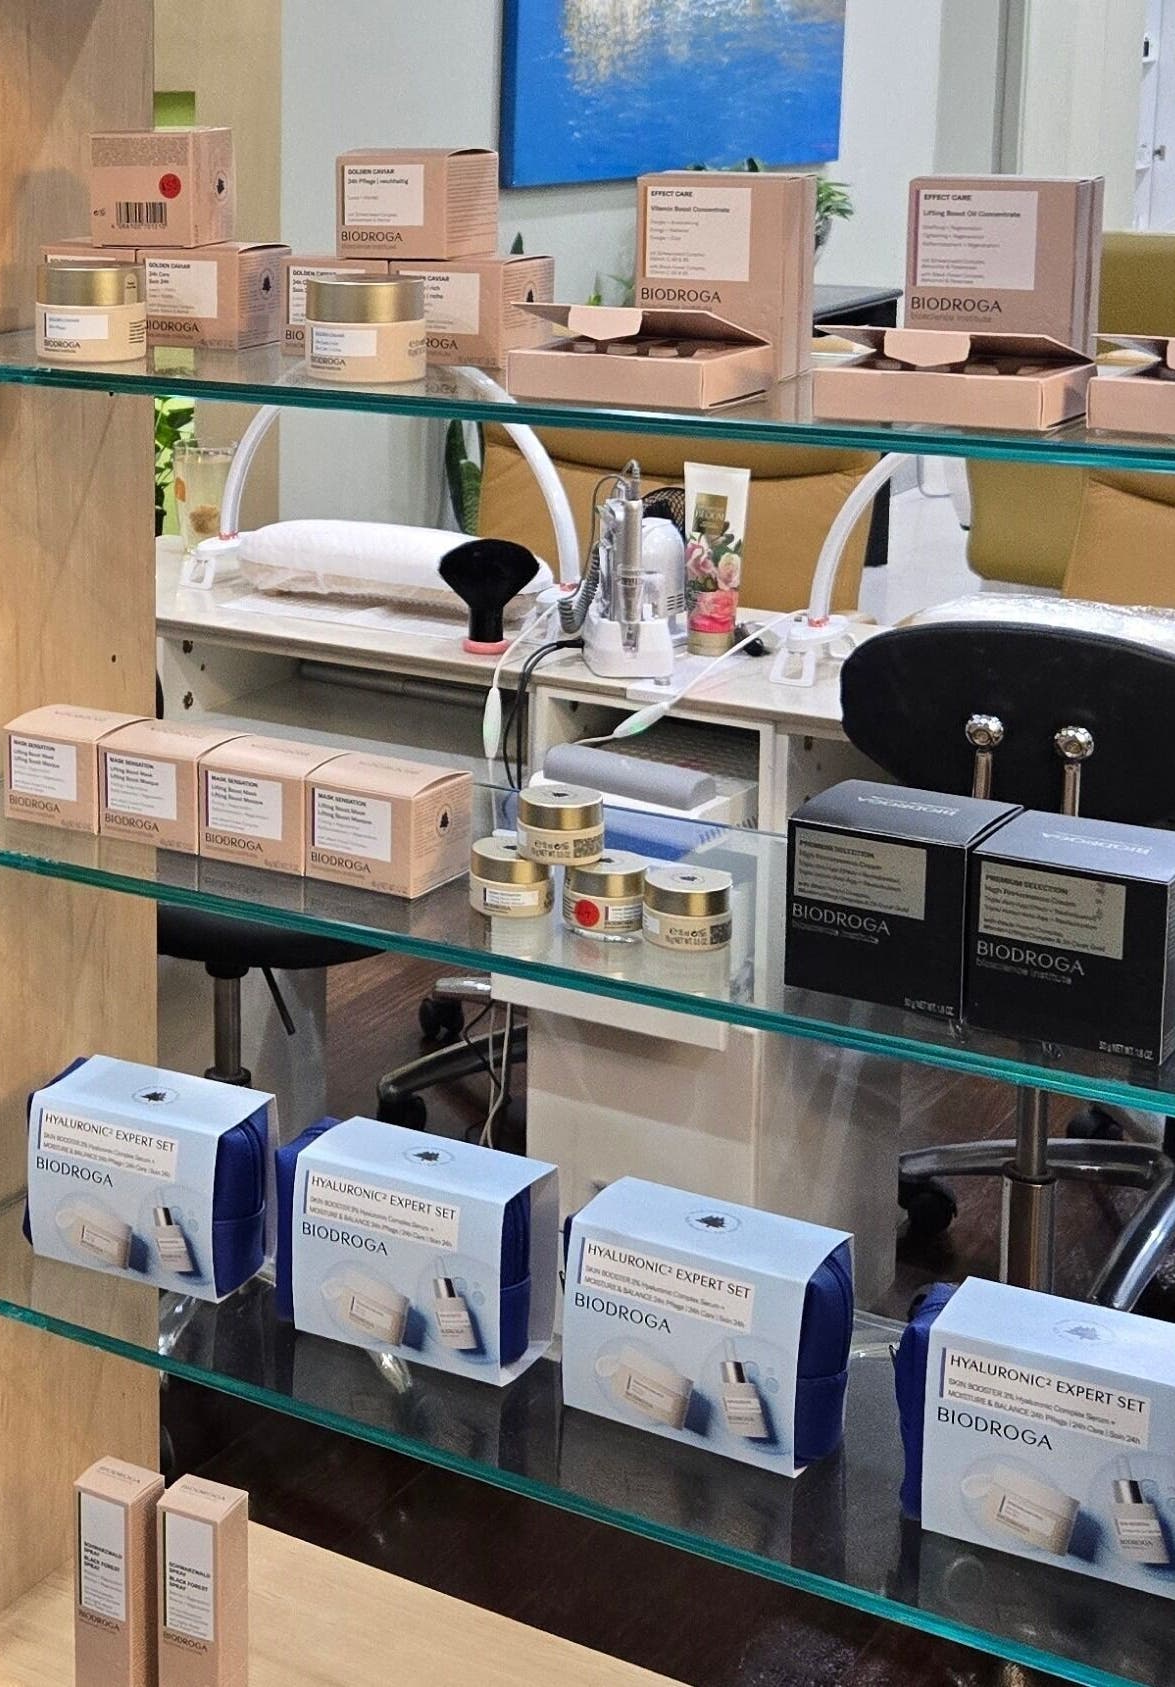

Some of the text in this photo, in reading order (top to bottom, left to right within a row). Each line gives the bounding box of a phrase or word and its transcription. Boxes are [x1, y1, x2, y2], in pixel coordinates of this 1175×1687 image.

[924, 193, 950, 201] EFFECT
[341, 231, 403, 242] BIODROGA
[641, 287, 722, 304] BIODROGA
[910, 296, 1003, 313] BIODROGA
[9, 794, 61, 813] BIODROGA
[105, 813, 160, 832] BIODROGA
[205, 832, 264, 853] BIODROGA
[310, 851, 371, 873] BIODROGA
[985, 874, 1069, 895] PREMIUM SELECTION
[792, 902, 891, 936] BIODROGA
[976, 940, 1086, 976] BIODROGA
[115, 1129, 154, 1147] EXPERT
[156, 1139, 176, 1153] SET
[36, 1156, 114, 1188] BIODROGA
[311, 1175, 457, 1221] HYALURONIC² EXPERT SET
[302, 1221, 388, 1256] BIODROGA
[588, 1243, 752, 1299] HYALURONIC² EXPERT SET
[574, 1292, 672, 1335] BIODROGA
[950, 1354, 1146, 1414] HYALURONIC² EXPERT SET
[937, 1406, 1054, 1451] BIODROGA
